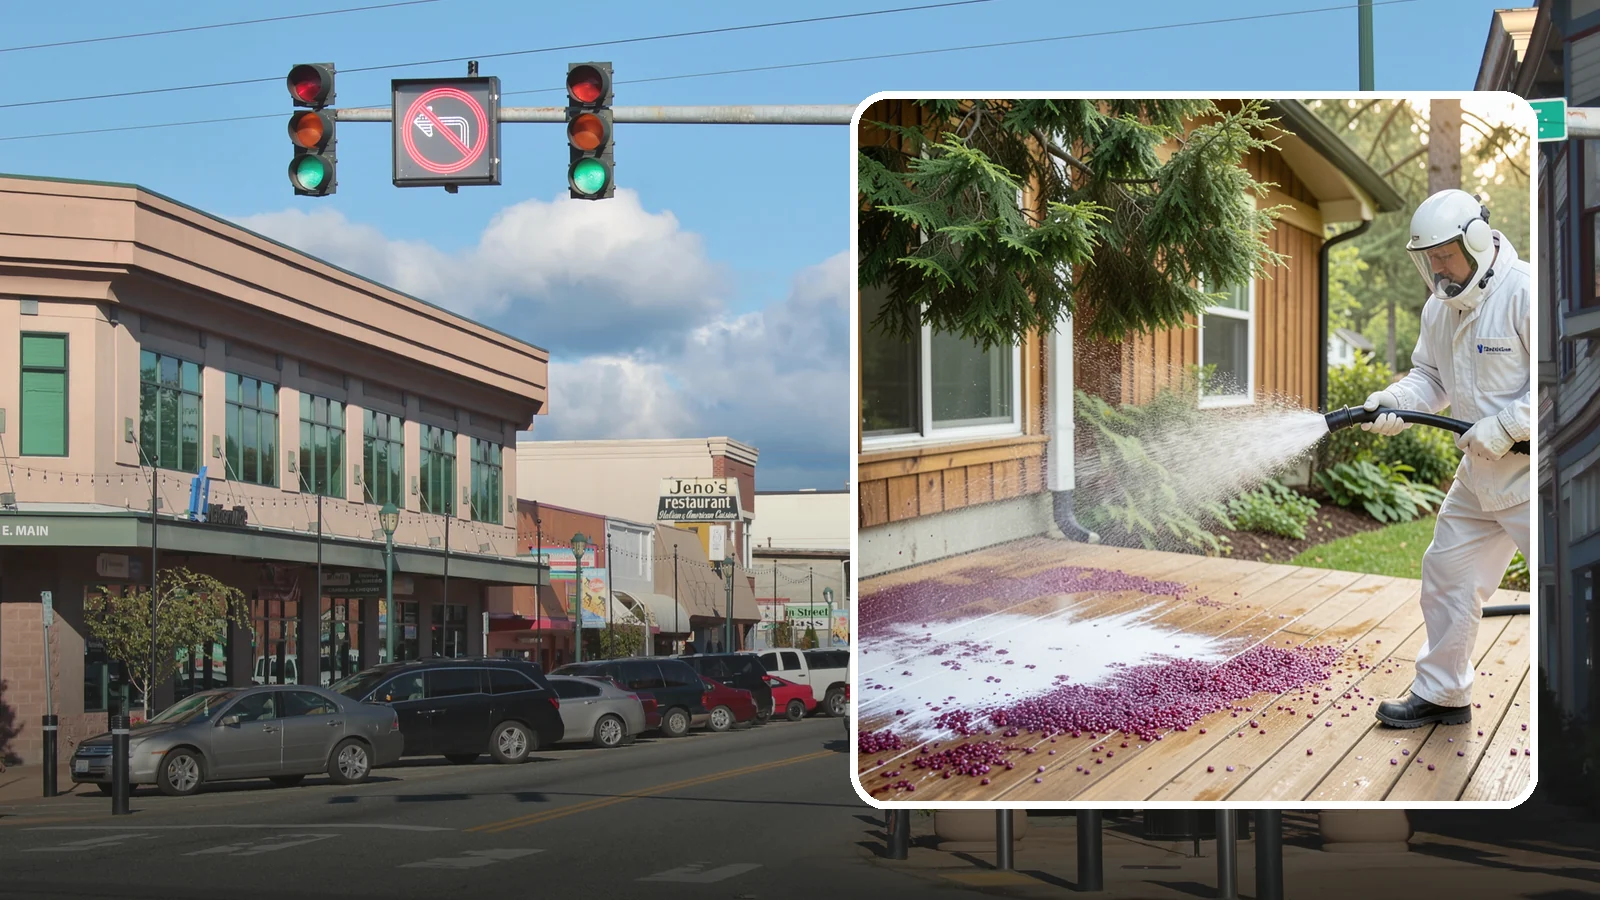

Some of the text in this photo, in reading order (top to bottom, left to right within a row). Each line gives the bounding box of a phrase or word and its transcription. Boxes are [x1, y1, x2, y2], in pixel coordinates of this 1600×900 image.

[670, 480, 727, 494] Jeno's
[665, 496, 731, 508] restaurant
[686, 510, 714, 519] American
[715, 510, 737, 519] Cuisine
[2, 525, 49, 536] E. MAIN
[797, 608, 829, 616] Street
